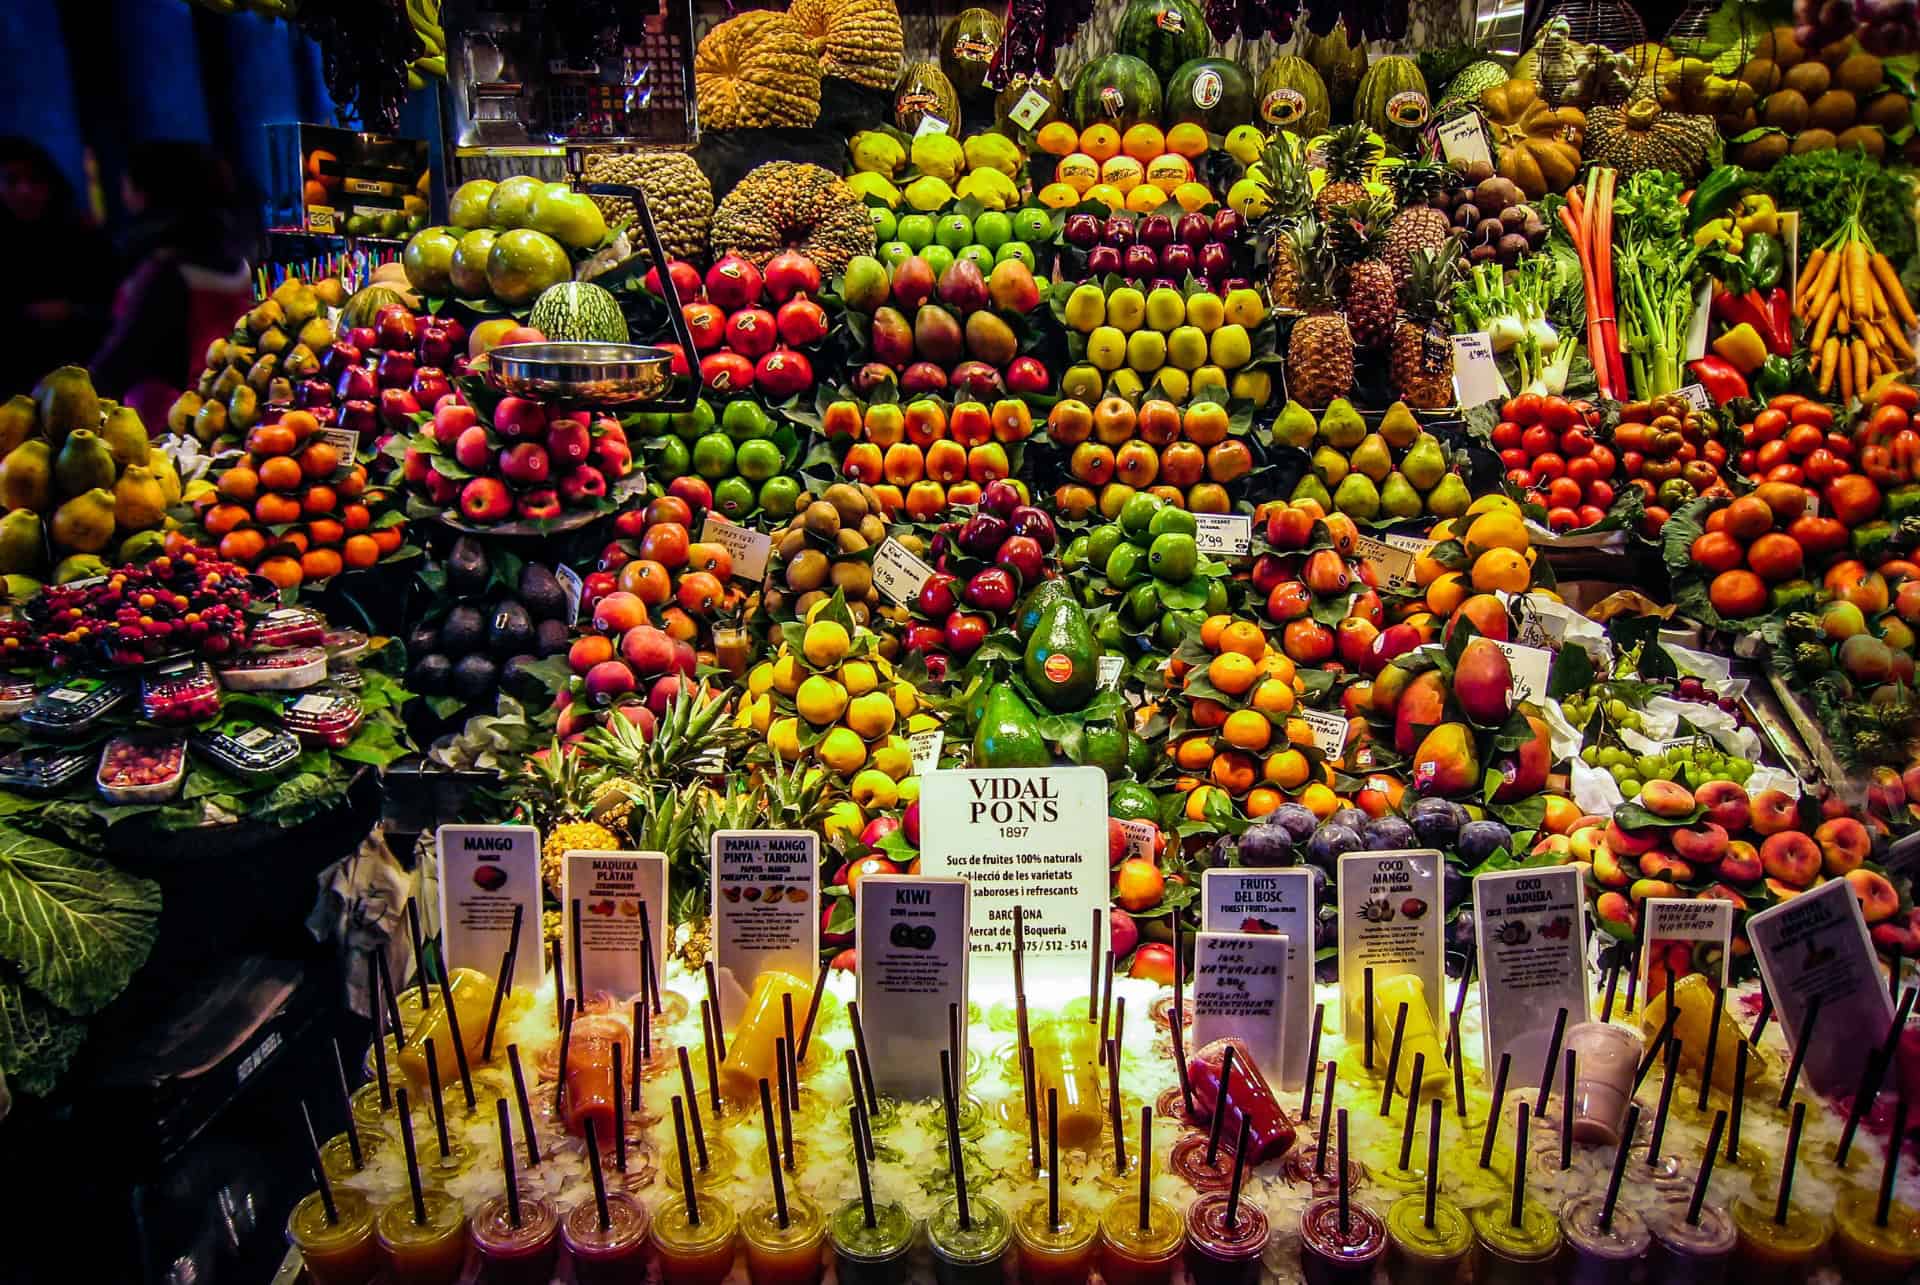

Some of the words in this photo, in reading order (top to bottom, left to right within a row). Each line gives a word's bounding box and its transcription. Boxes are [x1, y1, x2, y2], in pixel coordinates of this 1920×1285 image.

[968, 777, 1058, 799] VIDAL
[969, 800, 1058, 823] PONS
[1000, 826, 1029, 838] 1897
[464, 837, 512, 850] MANGO
[725, 840, 760, 850] PAPAIA
[769, 840, 806, 851] MANGO
[723, 852, 753, 863] PINYA
[764, 852, 807, 863] TARONJA
[946, 855, 967, 865] Sucs
[969, 855, 980, 865] de
[983, 854, 1013, 865] fruites
[1016, 854, 1041, 864] 100%
[1043, 853, 1083, 864] naturals
[1378, 861, 1403, 871] COCO
[1003, 870, 1014, 880] de
[1016, 870, 1028, 880] les
[1031, 870, 1073, 880] varietats
[1372, 872, 1409, 884] MANGO
[1240, 879, 1277, 889] FRUITS
[1516, 879, 1541, 890] COCO
[896, 888, 930, 904] KIWI
[974, 887, 1019, 897] saboroses
[1021, 886, 1024, 896] i
[1026, 885, 1079, 896] refrescants
[1234, 891, 1254, 902] DEL
[1256, 891, 1283, 902] BOSC
[1221, 904, 1244, 912] FOREST
[1245, 904, 1267, 912] FRUITS
[988, 910, 1042, 920] BARCONA
[1000, 925, 1011, 936] de
[1024, 925, 1066, 937] Boqueria
[984, 942, 993, 952] n.
[996, 942, 1012, 952] 471
[1046, 940, 1063, 950] 512
[1070, 940, 1087, 951] 514
